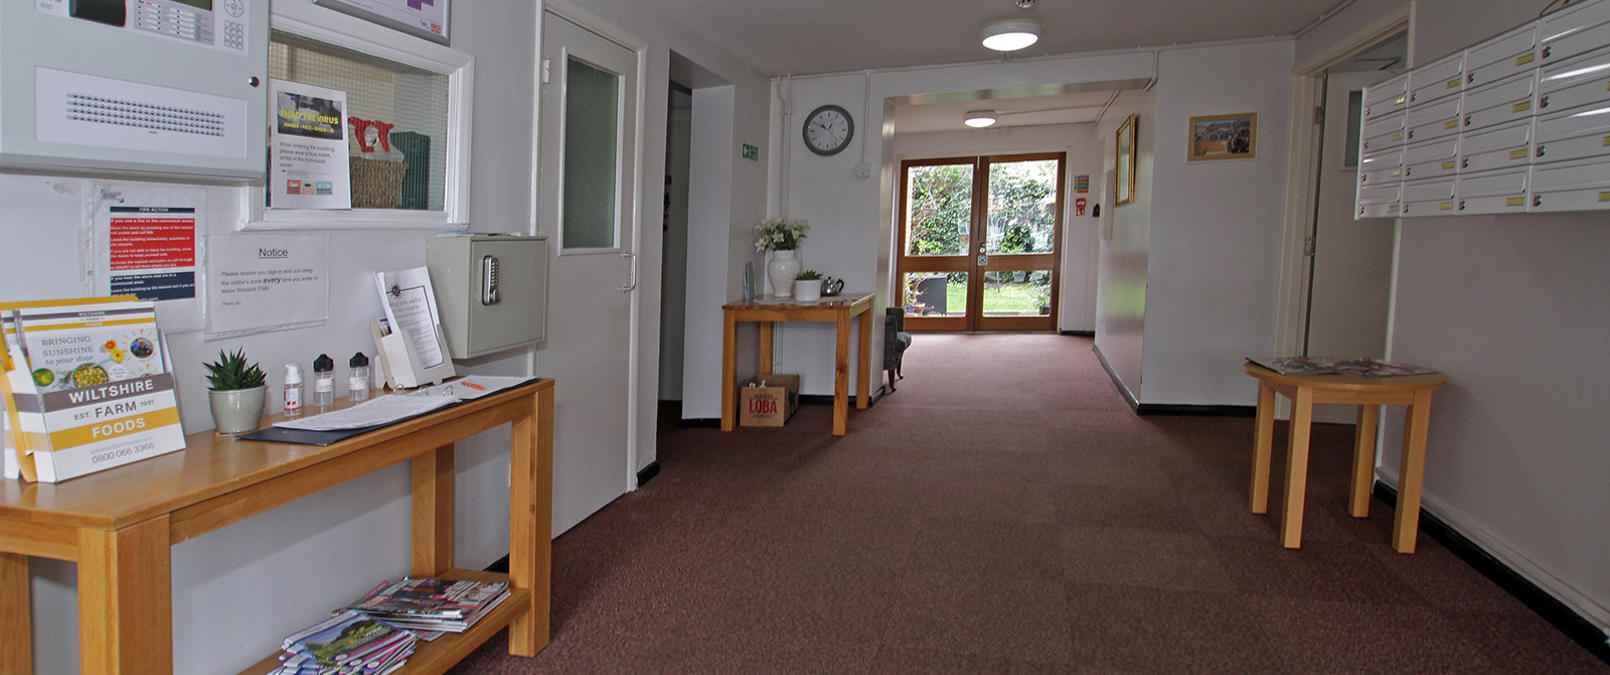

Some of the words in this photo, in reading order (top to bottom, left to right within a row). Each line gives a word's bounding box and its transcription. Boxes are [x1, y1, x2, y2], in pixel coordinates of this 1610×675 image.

[317, 114, 339, 125] VIRUS
[258, 247, 288, 258] Notice
[41, 335, 92, 346] BRINGING
[42, 346, 94, 357] SUNSHINE
[56, 357, 75, 366] your
[76, 354, 94, 362] door
[69, 379, 154, 404] WILTSHIRE
[95, 401, 137, 418] FARM
[140, 399, 155, 408] 1991
[748, 399, 777, 414] LOBA
[92, 417, 146, 439] FOODS
[92, 453, 115, 464] 0800
